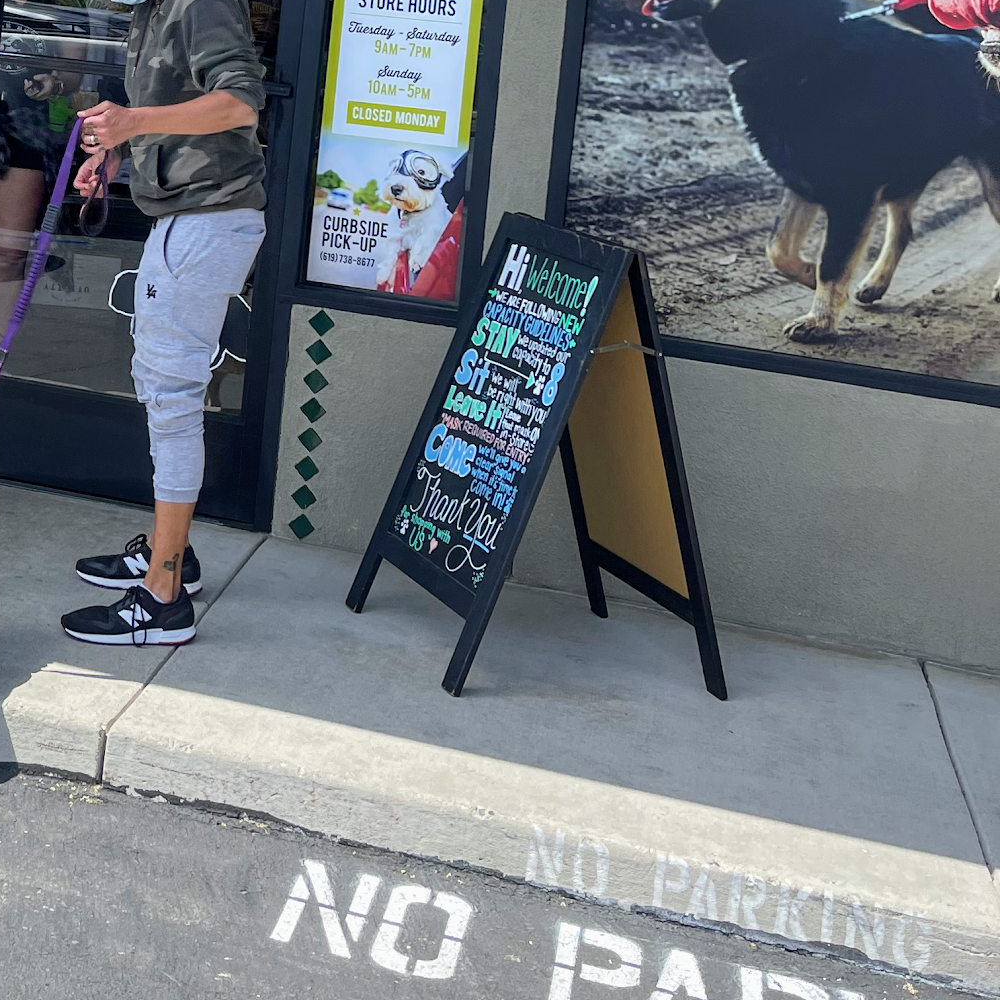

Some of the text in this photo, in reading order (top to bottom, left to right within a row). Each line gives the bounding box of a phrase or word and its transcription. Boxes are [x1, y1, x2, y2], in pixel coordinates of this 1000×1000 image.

[348, 21, 395, 39] Tuesday
[405, 27, 461, 46] Saturday
[374, 39, 398, 55] 9AM
[409, 42, 431, 59] 7PM
[377, 65, 422, 83] Sunday
[368, 80, 397, 96] 10AM
[407, 83, 431, 100] 5PM
[352, 106, 440, 128] CLOSED MONDAY
[323, 215, 389, 238] CURBSIDE
[321, 232, 377, 253] PICK-UP
[319, 251, 375, 268] (619) 738-8677
[525, 254, 599, 317] Welcome!
[483, 300, 572, 352] CAPACITY GUIDELINES
[495, 290, 585, 336] WE ARE FOLLOWING NEW
[471, 317, 521, 359] STAY
[454, 348, 490, 395] Sit
[542, 357, 551, 374] to
[487, 384, 497, 399] be
[541, 362, 566, 406] 8
[463, 420, 495, 444] REQUIRED
[493, 438, 507, 452] FOR
[410, 466, 471, 530] Thank
[525, 822, 932, 973] NO PARKING
[269, 858, 473, 979] NO
